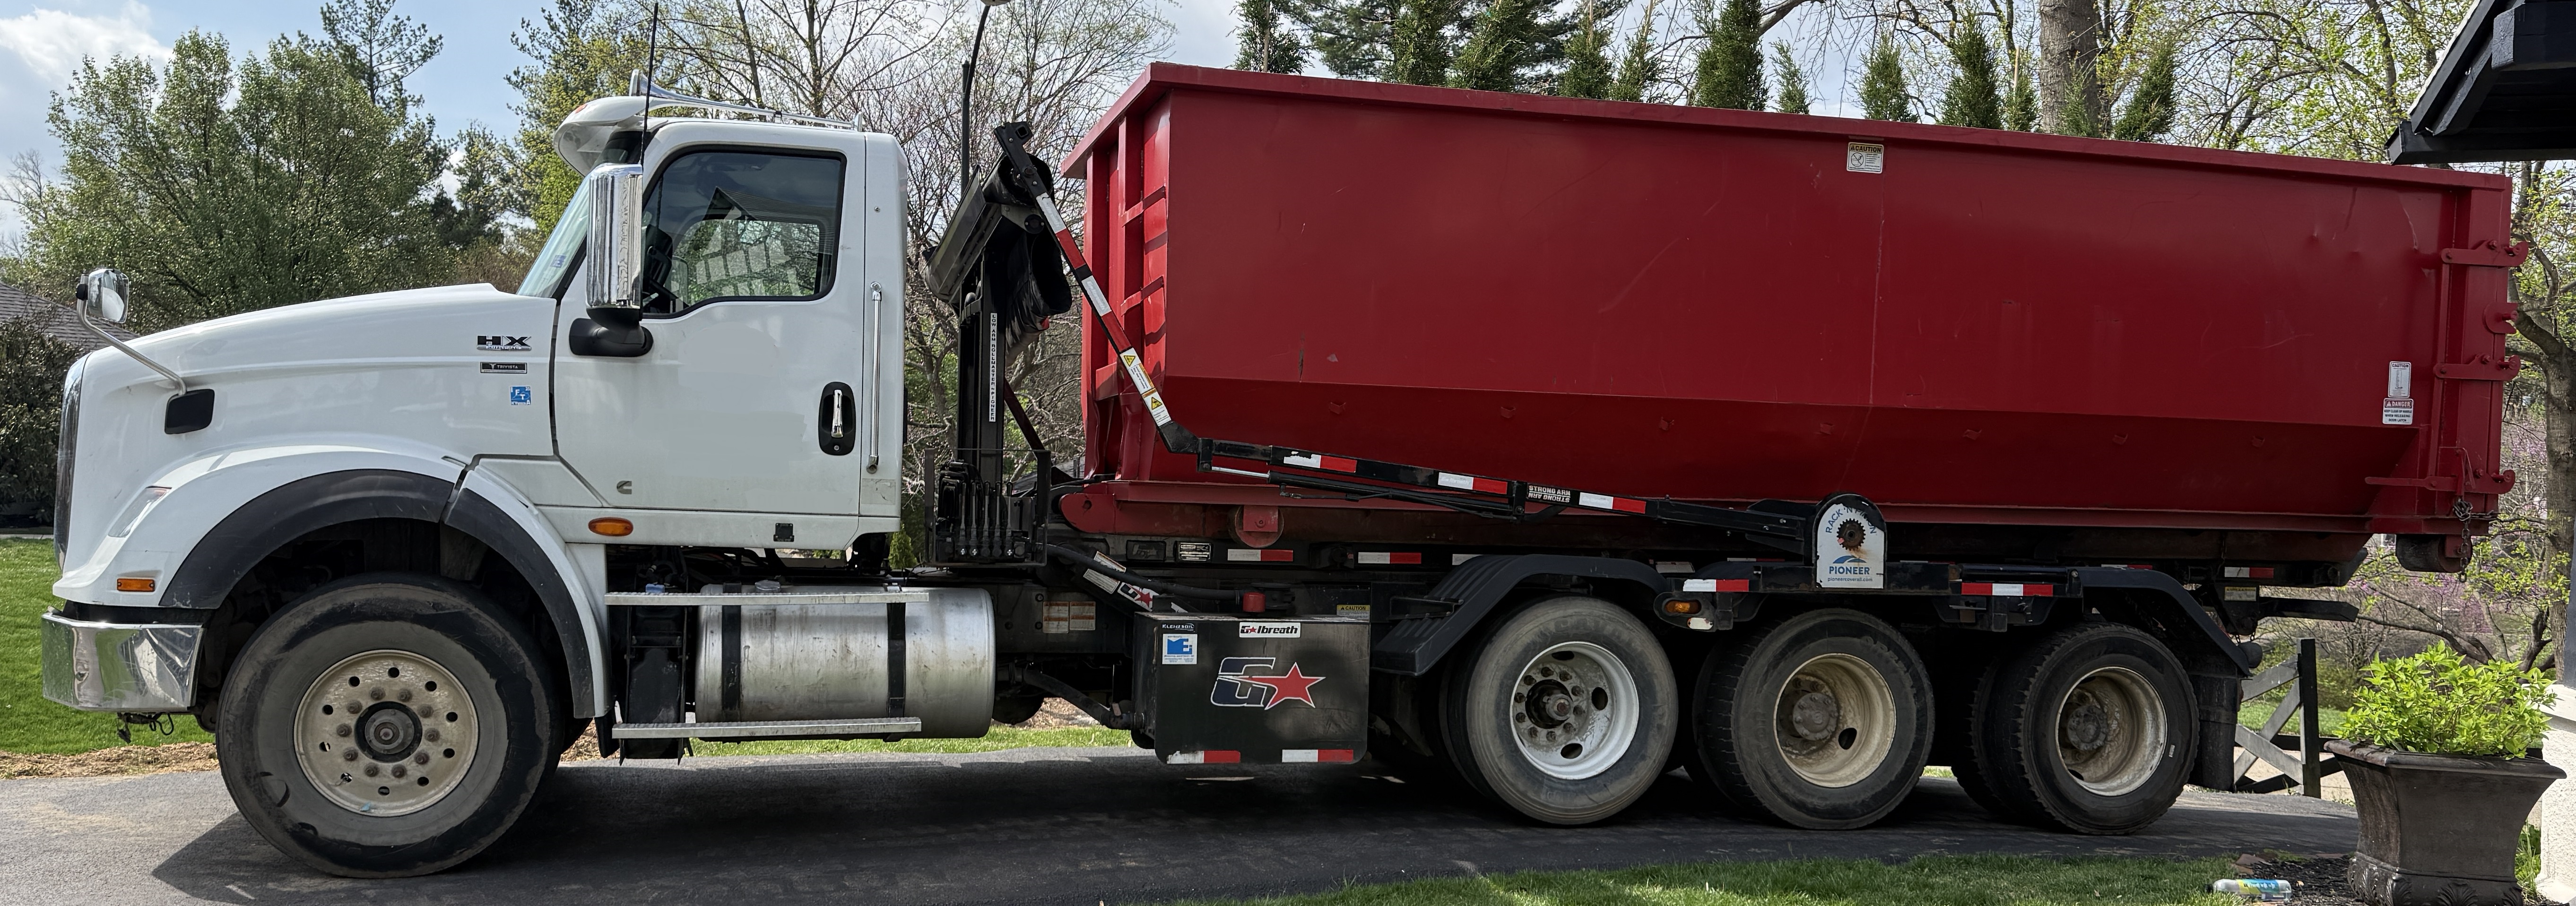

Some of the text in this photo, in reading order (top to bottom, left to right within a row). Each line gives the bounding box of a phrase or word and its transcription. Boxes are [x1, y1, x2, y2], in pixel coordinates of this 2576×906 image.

[477, 336, 530, 347] HX
[1529, 485, 1556, 494] STRONG
[1543, 494, 1570, 503] STRONG
[1826, 509, 1843, 533] RACK
[1829, 567, 1870, 575] PIONEER
